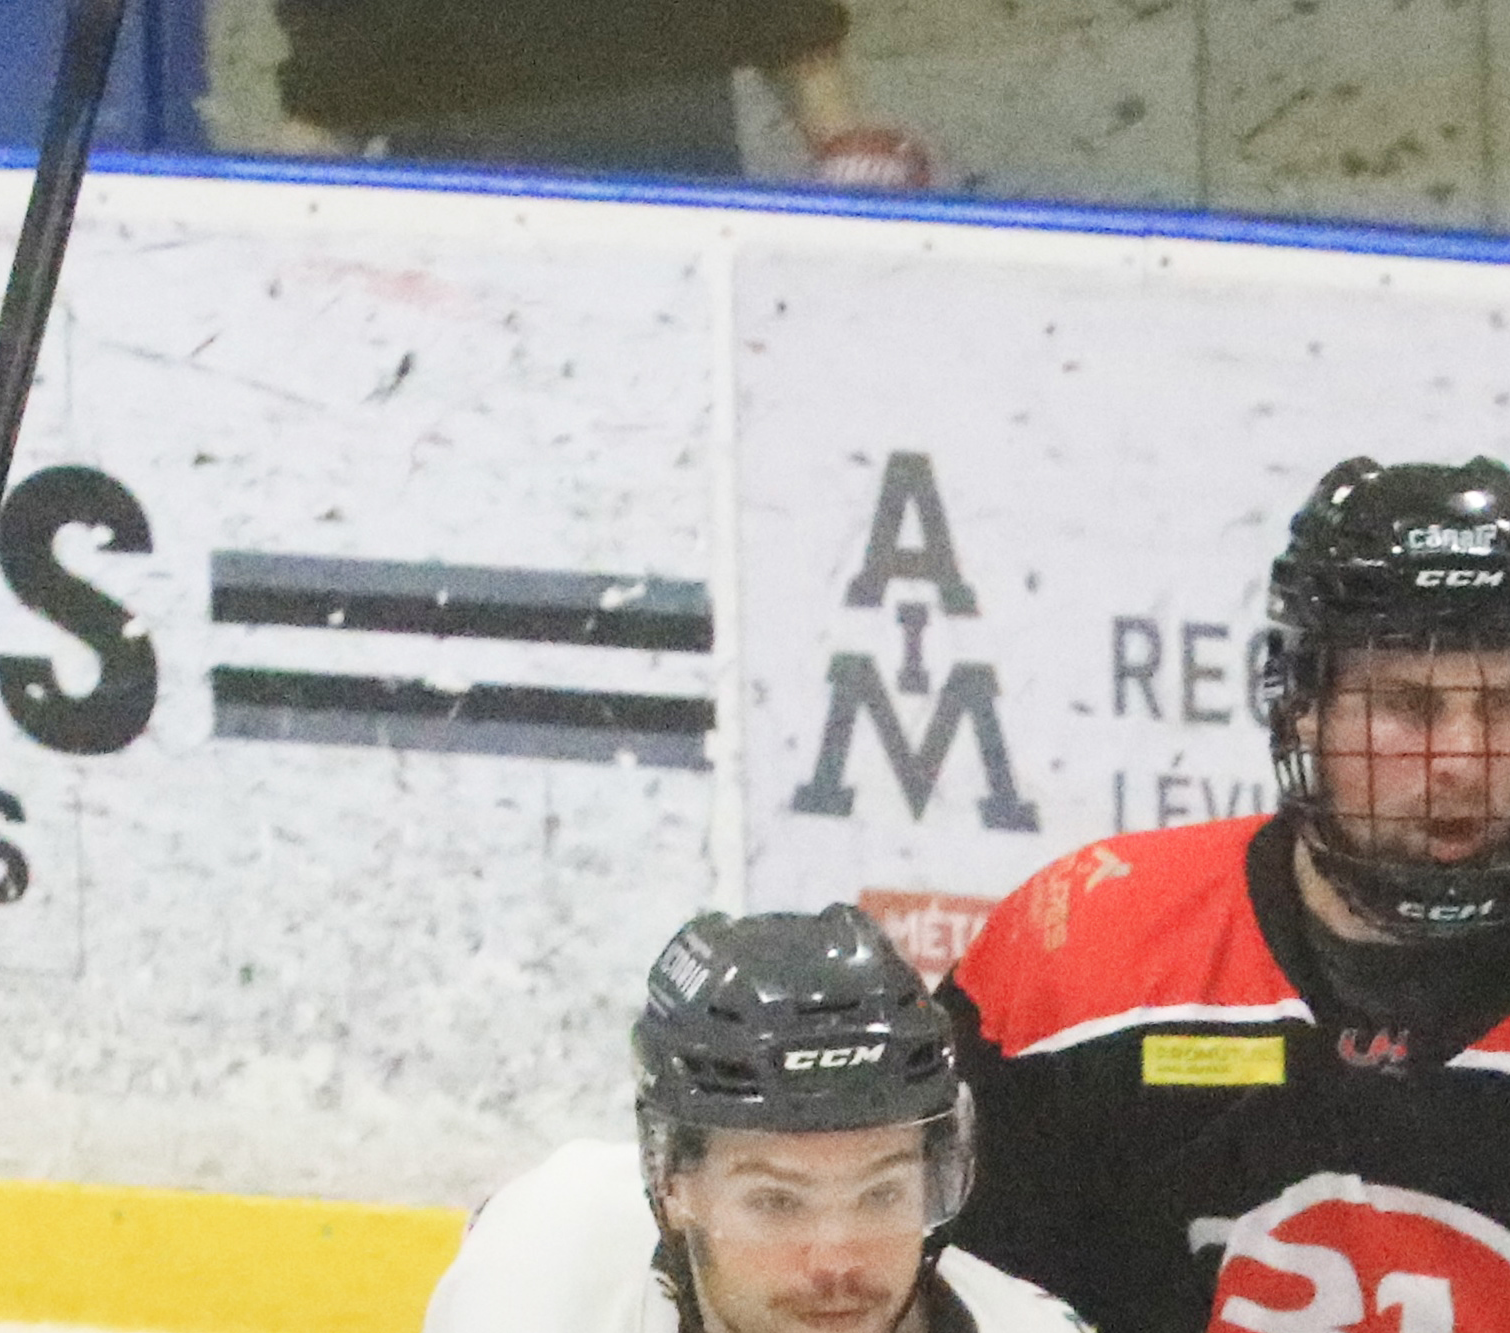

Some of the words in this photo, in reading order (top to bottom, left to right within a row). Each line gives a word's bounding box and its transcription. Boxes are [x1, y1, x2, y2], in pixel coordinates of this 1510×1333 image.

[1415, 569, 1506, 588] CCM
[1396, 899, 1494, 923] CCM
[783, 1042, 886, 1071] CCM
